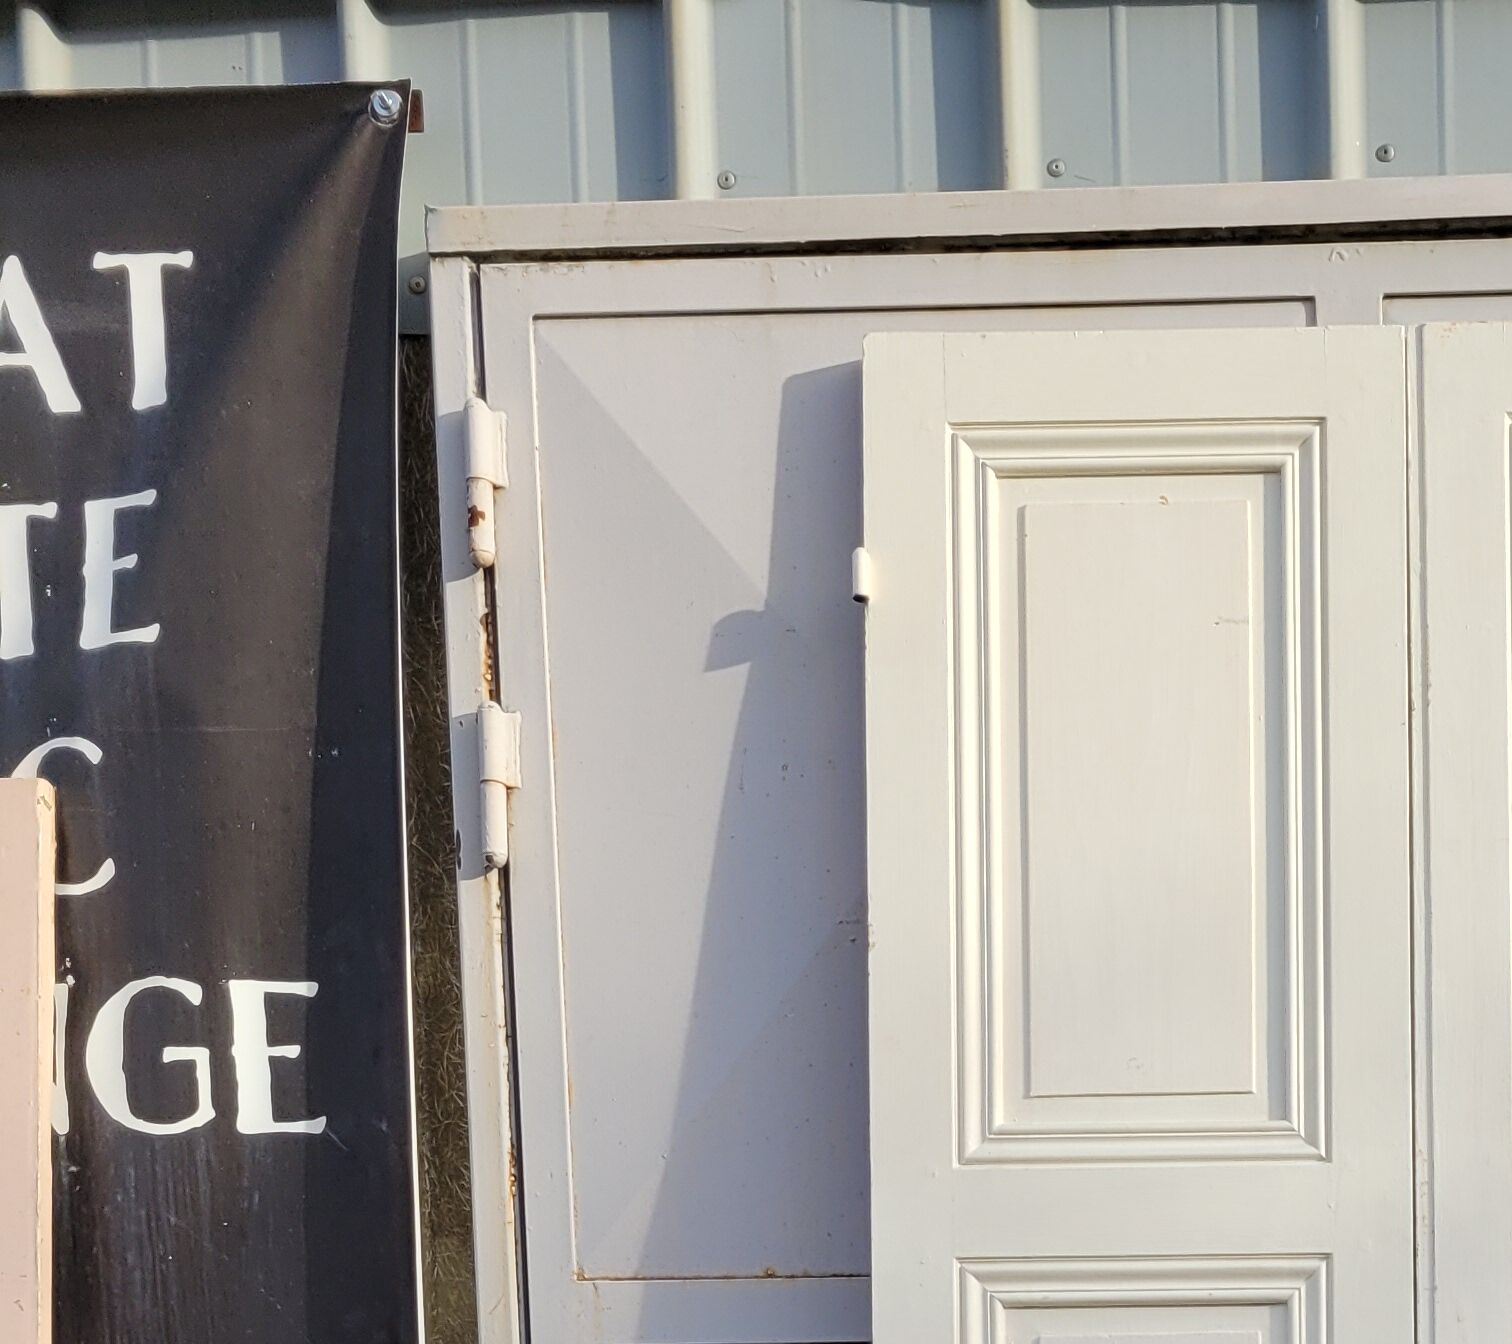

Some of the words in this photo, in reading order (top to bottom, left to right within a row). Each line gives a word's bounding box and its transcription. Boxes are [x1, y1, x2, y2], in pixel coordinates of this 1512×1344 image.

[0, 250, 194, 416] AT
[0, 489, 161, 661] TE
[52, 976, 327, 1136] GE
